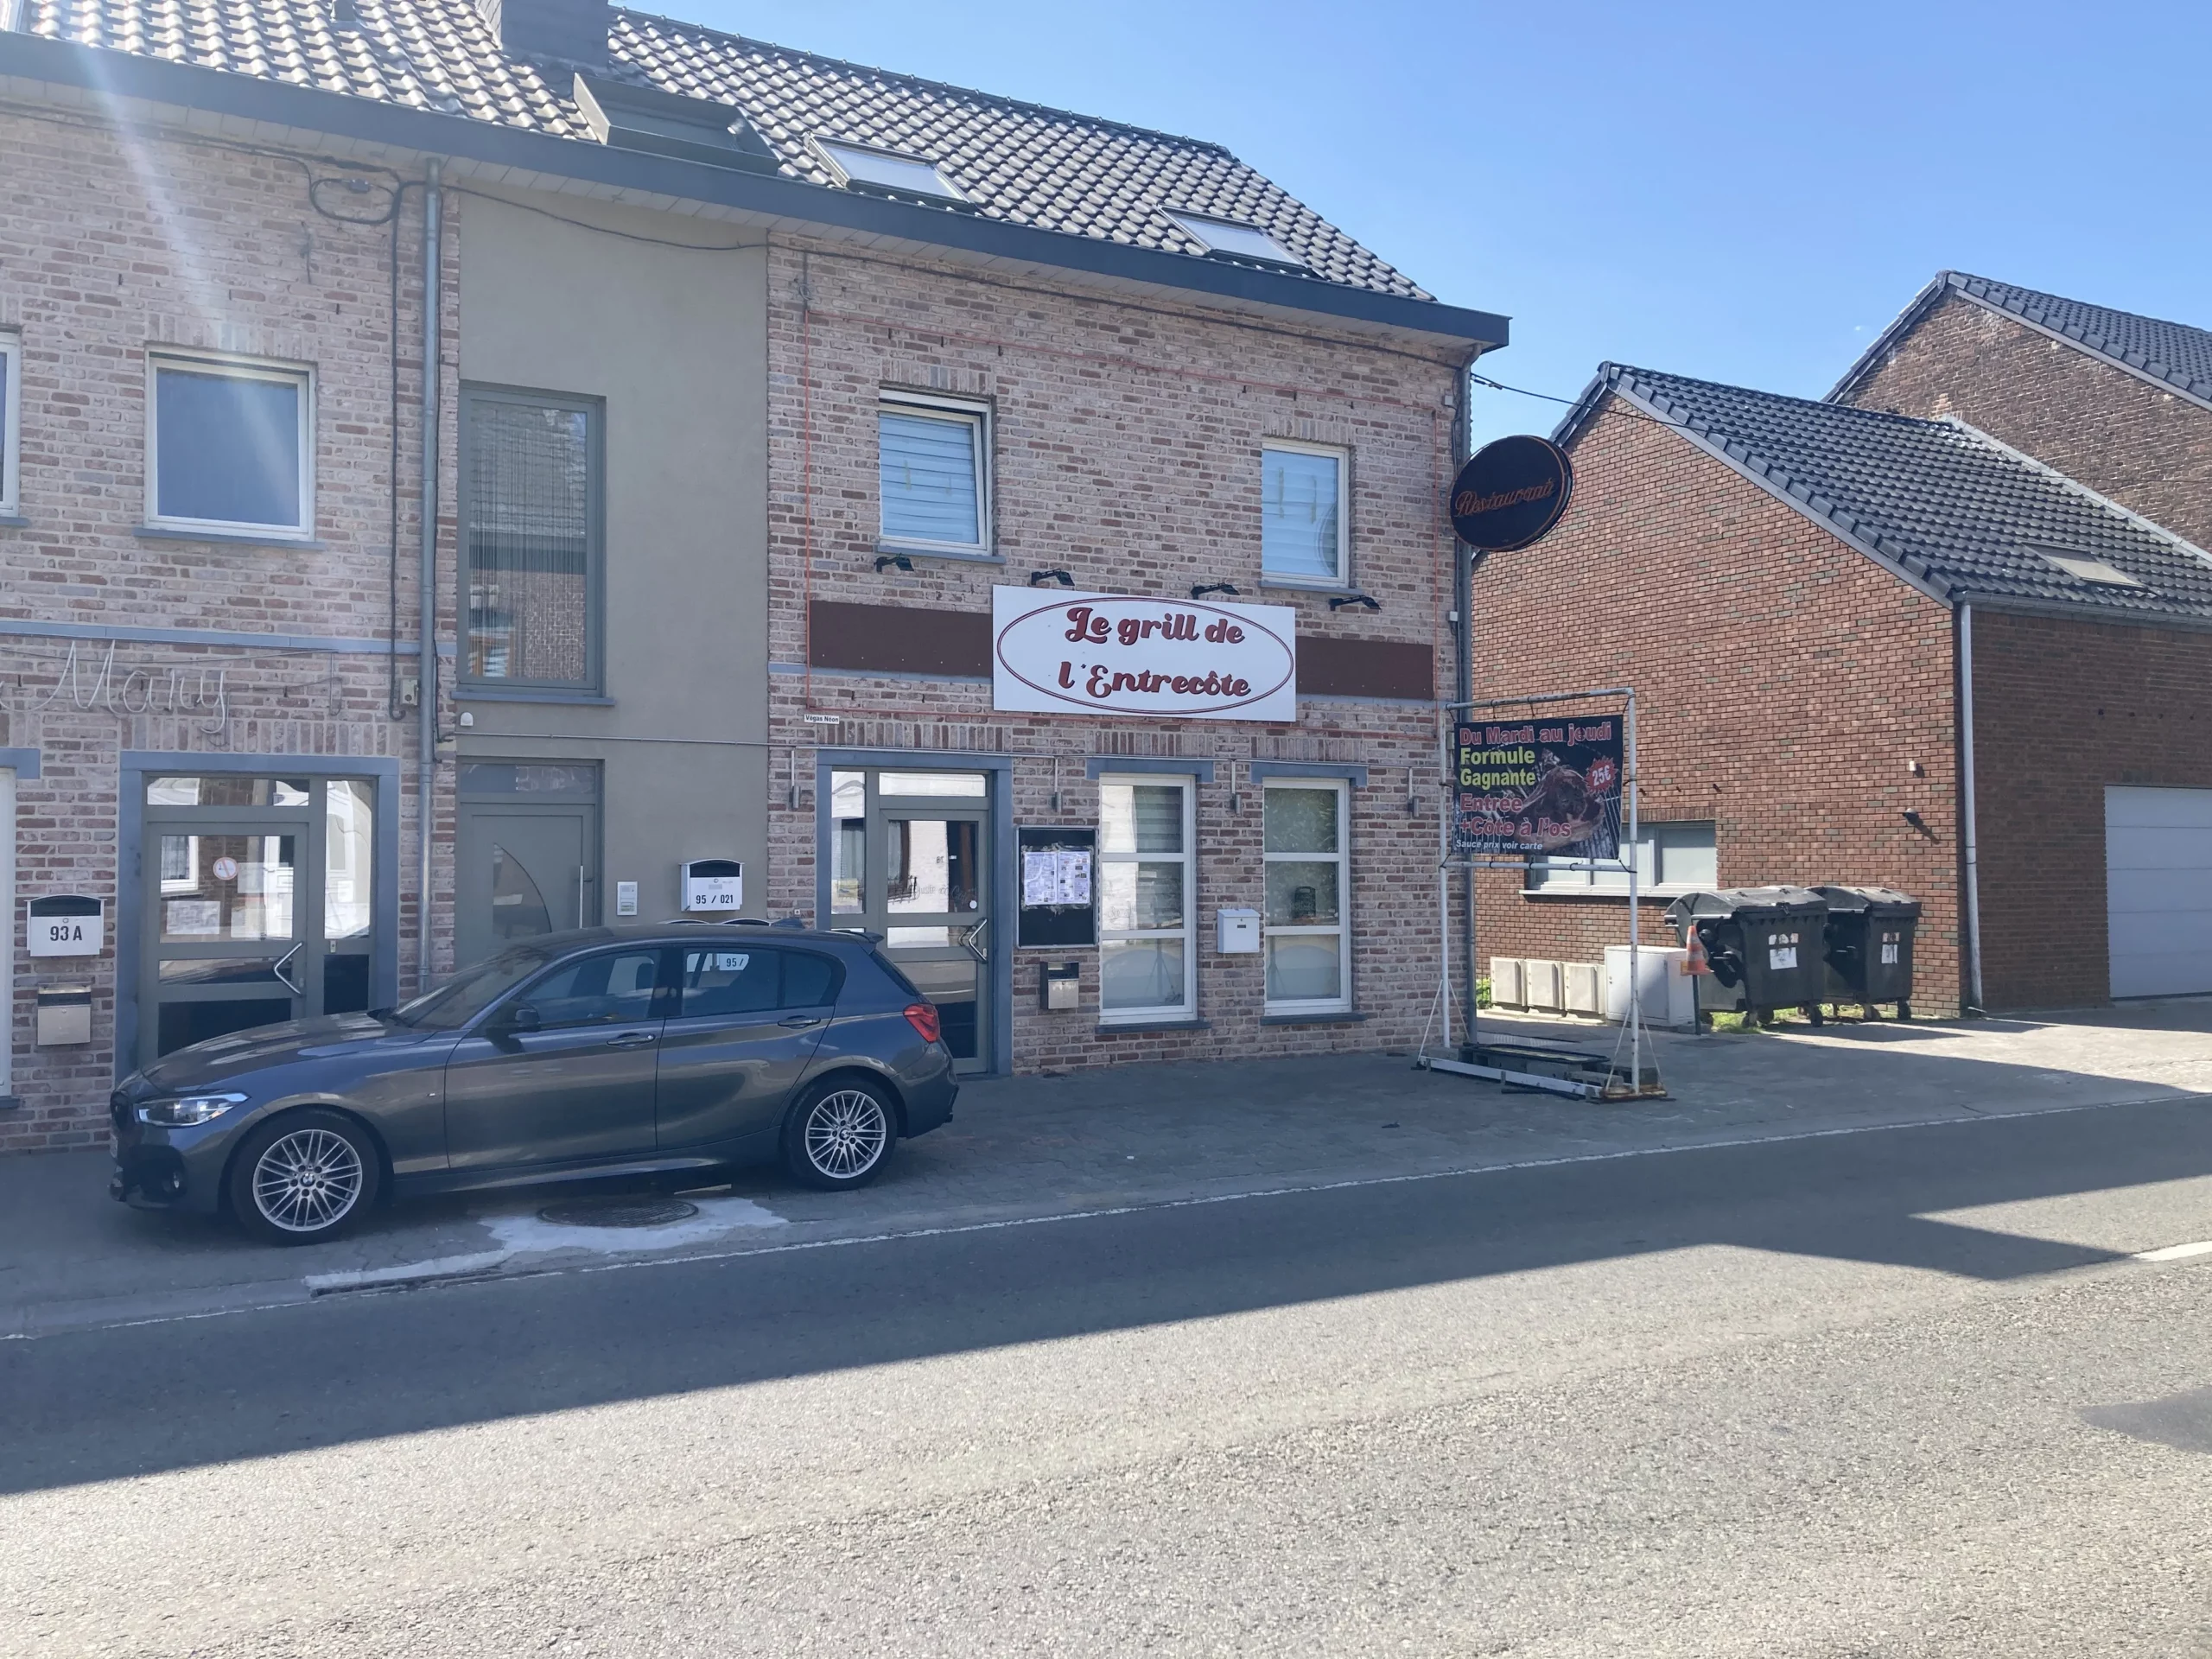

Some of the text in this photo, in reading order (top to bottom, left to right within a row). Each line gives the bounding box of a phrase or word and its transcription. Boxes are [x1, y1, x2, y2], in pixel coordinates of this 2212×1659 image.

[1454, 477, 1555, 518] Restaurant
[1065, 607, 1245, 645] Le grill de
[1058, 660, 1251, 698] l'Entrecôte
[1459, 721, 1611, 746] Du Mardi au jeudi
[1460, 747, 1535, 765] Formule
[1460, 768, 1535, 790] Gagnante
[1592, 766, 1611, 786] 25€
[1460, 793, 1522, 812] Entrée
[1520, 817, 1530, 836] à
[1538, 817, 1572, 837] l'os
[1456, 839, 1481, 848] Sauce
[1483, 841, 1499, 849] prix
[696, 895, 706, 904] 95
[721, 894, 734, 904] 021
[50, 925, 83, 942] 93 A
[726, 958, 737, 967] 95
